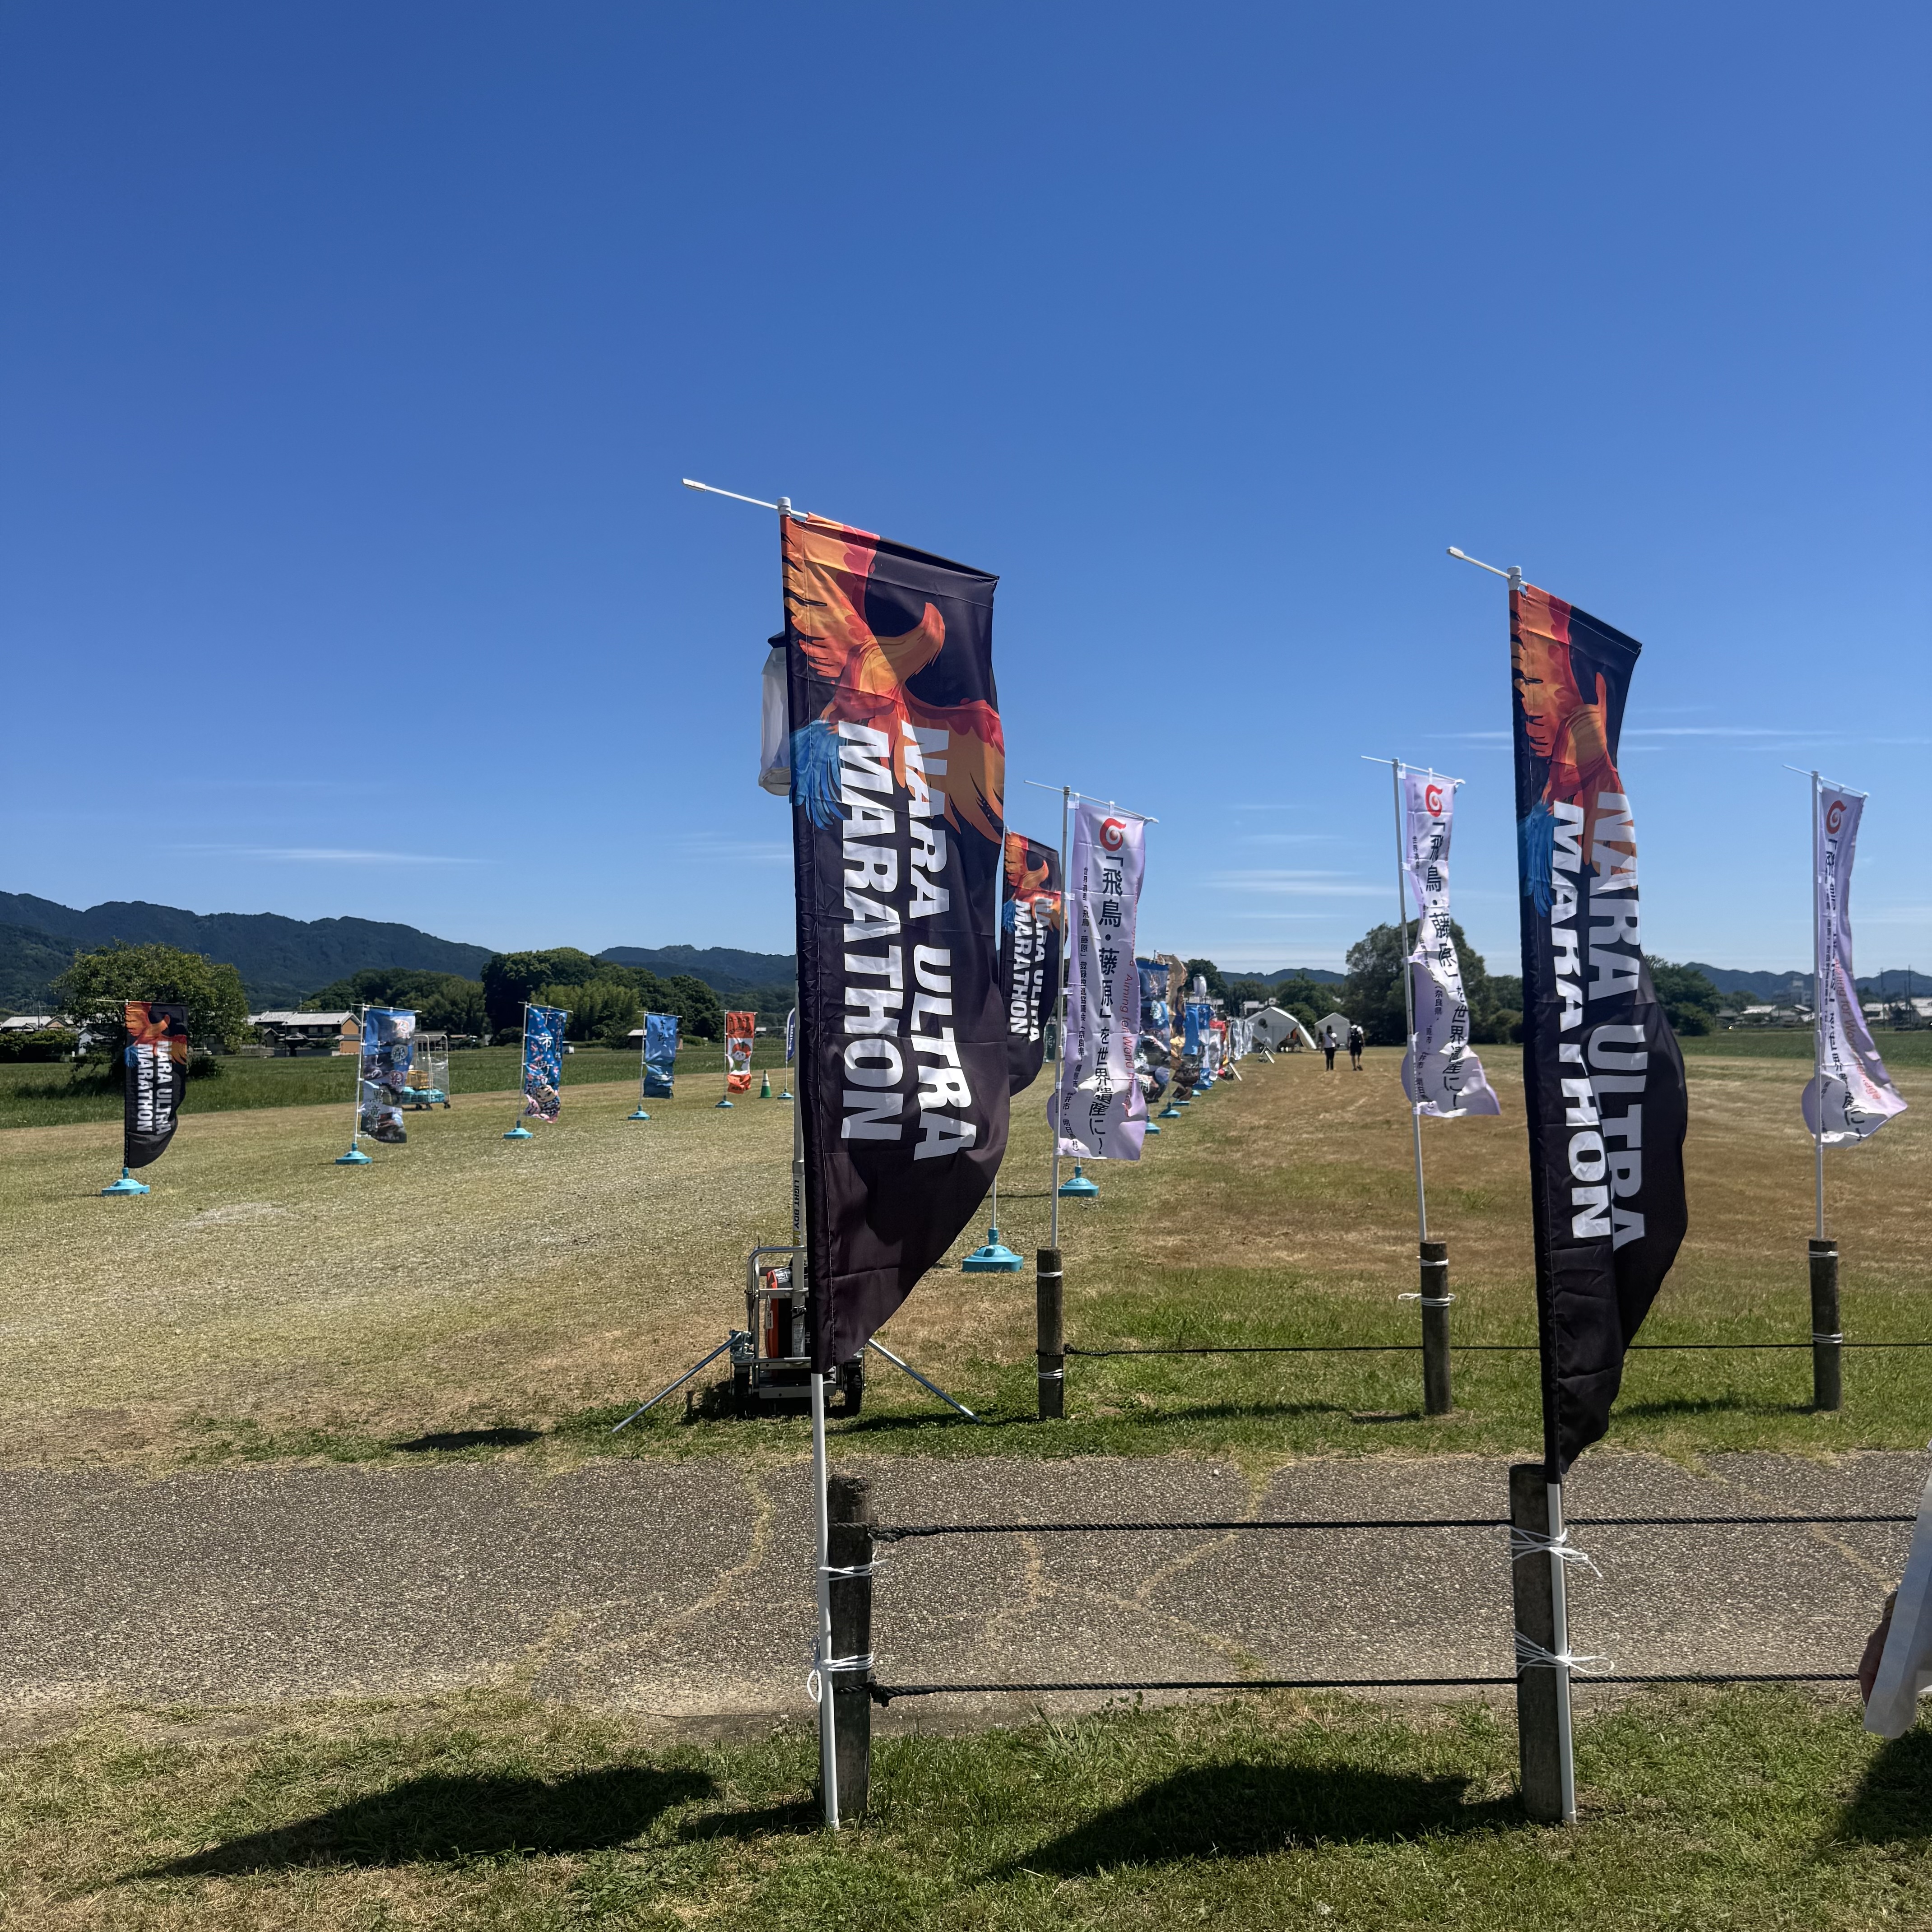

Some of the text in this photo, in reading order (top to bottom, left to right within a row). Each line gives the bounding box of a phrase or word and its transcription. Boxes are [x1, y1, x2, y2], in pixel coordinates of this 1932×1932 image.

[838, 720, 904, 1140] MARATHON
[901, 720, 977, 1161] NARA ULTRA
[1010, 899, 1032, 1034] MARATHON
[1034, 896, 1053, 962] NARA
[1120, 974, 1133, 1012] Aiming
[137, 1044, 153, 1131] MARATHON
[1551, 801, 1612, 1239] MARATHON
[1588, 792, 1648, 1252] NARA ULTRA
[156, 1041, 172, 1135] NARA ULTRA
